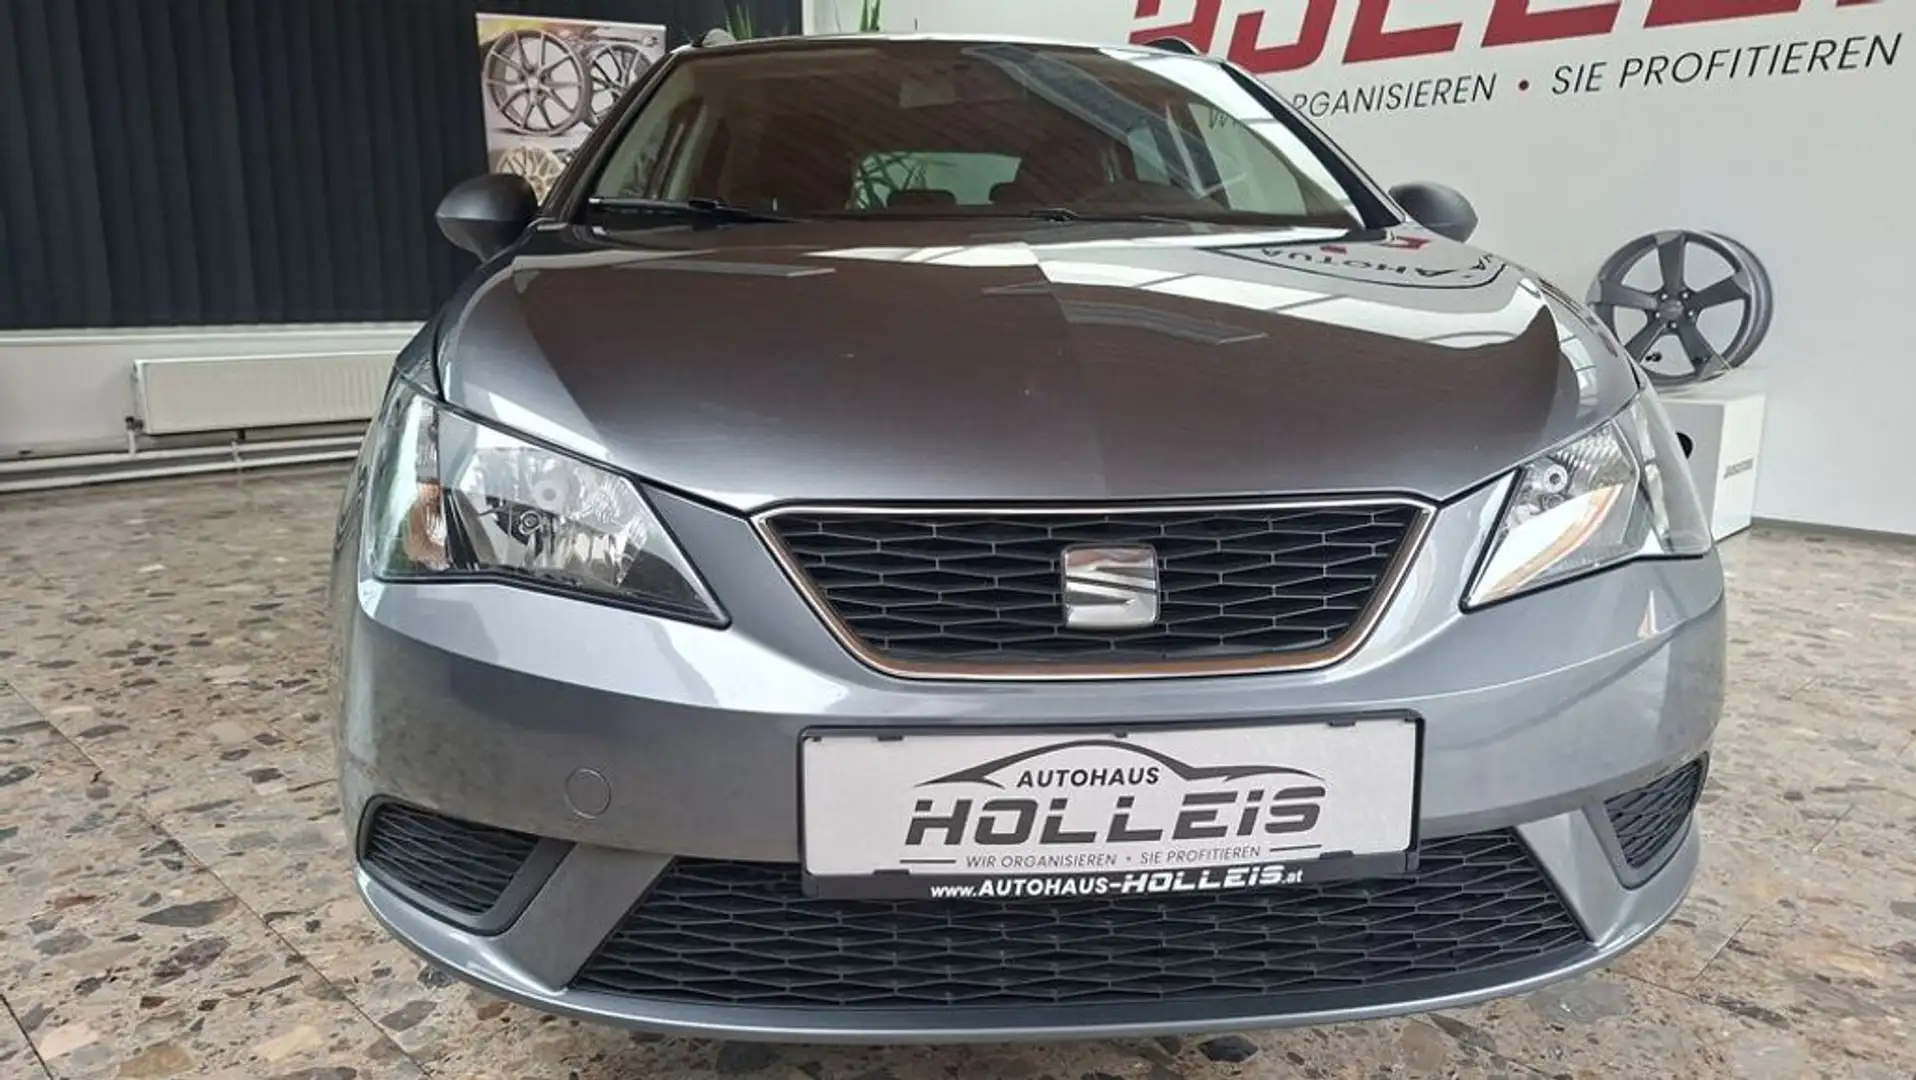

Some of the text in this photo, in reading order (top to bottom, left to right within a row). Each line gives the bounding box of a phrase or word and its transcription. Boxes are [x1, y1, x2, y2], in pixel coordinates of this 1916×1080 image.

[1292, 73, 1497, 118] RGANISIEREN
[1551, 61, 1607, 95] SIE
[1619, 32, 1903, 89] PROFITIEREN
[1016, 766, 1160, 788] AUTOHAUS
[965, 846, 1261, 868] WIR ORGANISIEREN SIE PROFITIEREN
